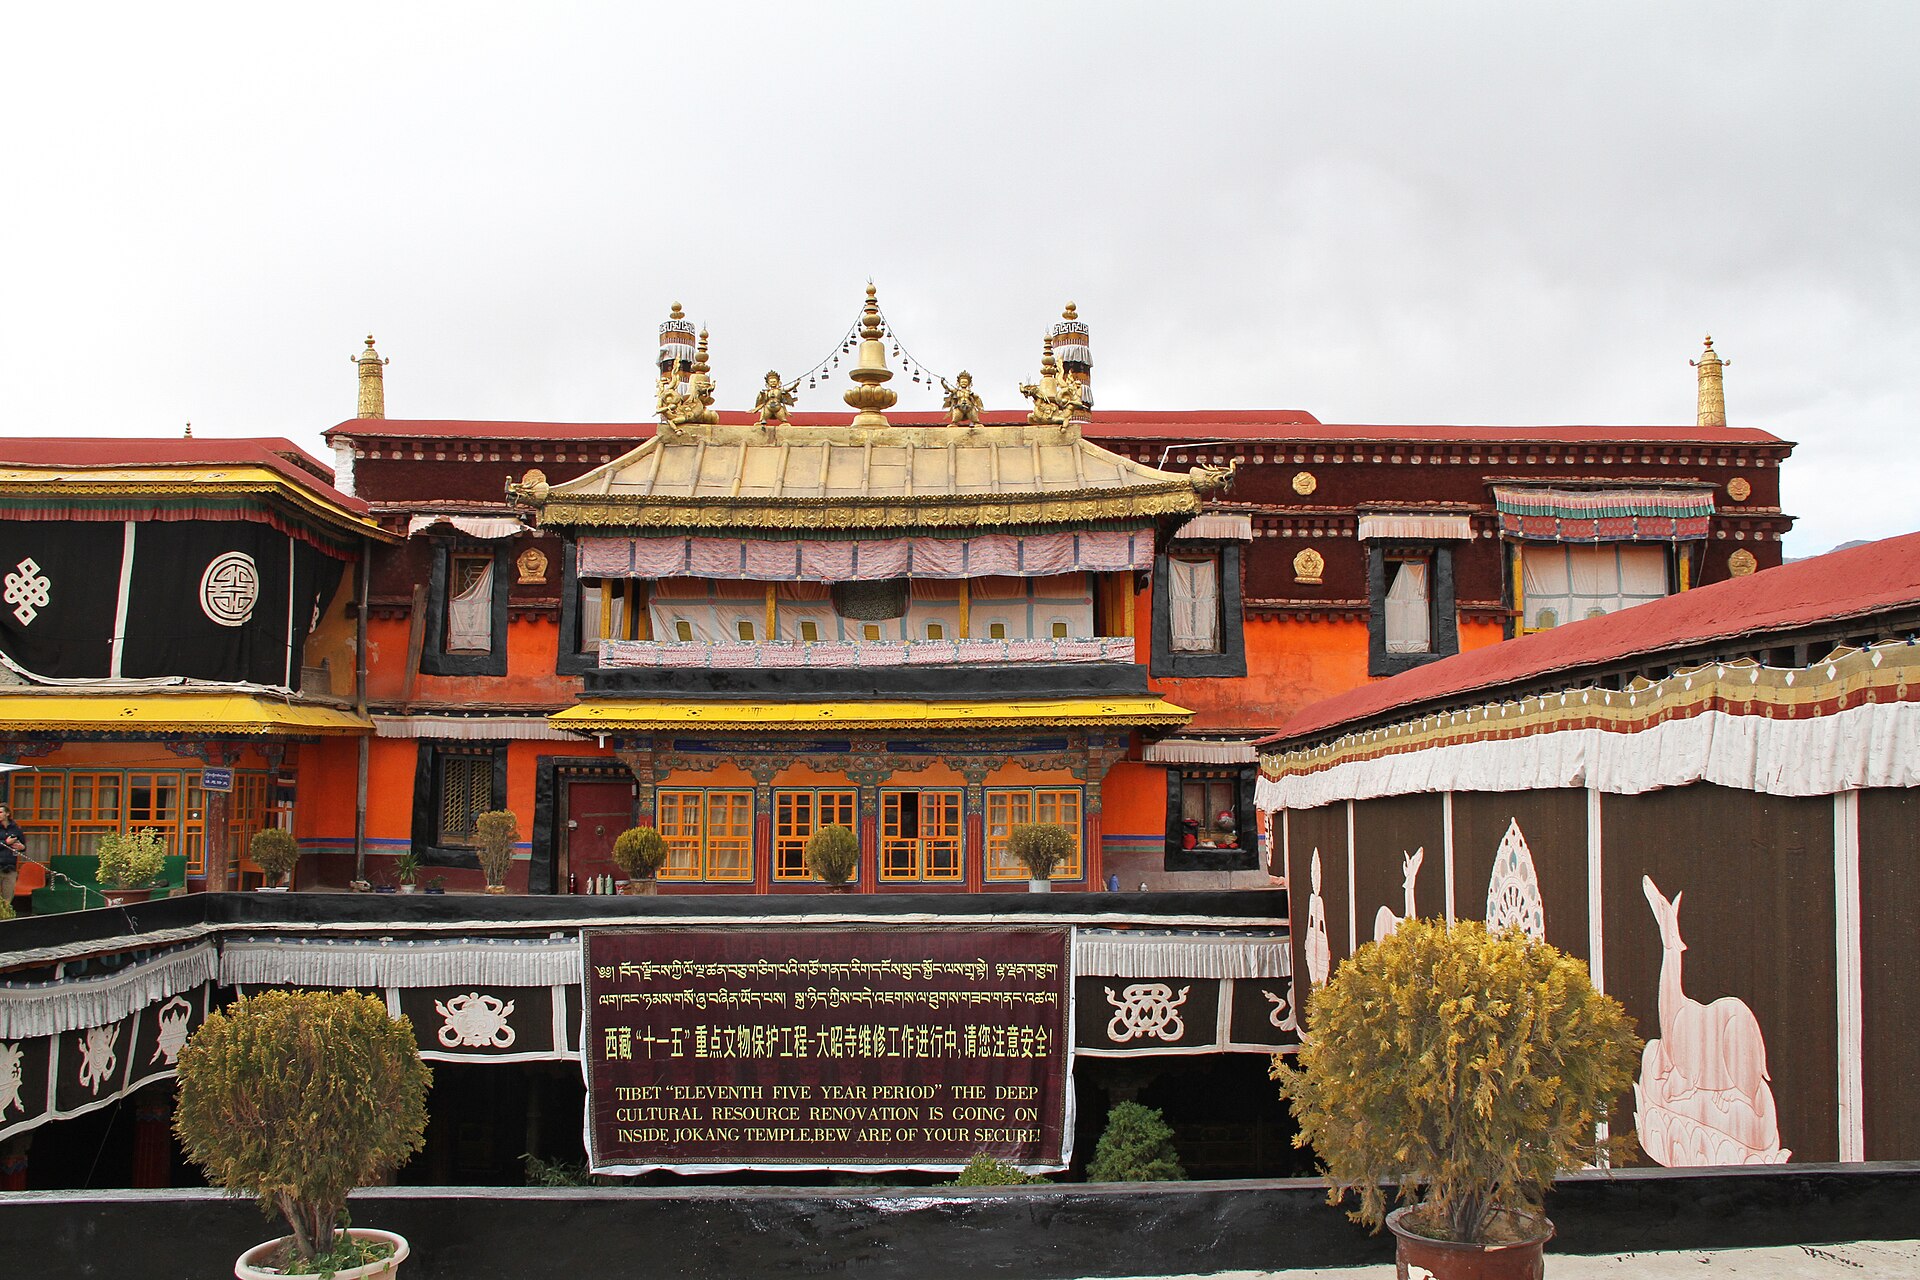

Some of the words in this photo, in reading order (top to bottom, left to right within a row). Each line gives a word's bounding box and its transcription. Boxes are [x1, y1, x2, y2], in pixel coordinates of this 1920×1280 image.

[615, 1086, 662, 1101] TIBET
[666, 1085, 763, 1100] “ELEVENTH
[772, 1085, 811, 1100] FIVE
[820, 1085, 867, 1100] YEAR
[872, 1084, 942, 1100] PERIOD”
[951, 1085, 986, 1100] THE
[995, 1086, 1038, 1100] DEEP
[616, 1107, 703, 1122] CULTURAL
[712, 1107, 800, 1121] RESOURCE
[809, 1107, 919, 1121] RENOVATION
[928, 1107, 944, 1121] IS
[952, 1107, 1006, 1121] GOING
[1015, 1107, 1038, 1121] ON
[618, 1129, 669, 1143] INSIDE
[673, 1128, 740, 1143] JOKANG
[896, 1128, 918, 1142] OF
[923, 1128, 970, 1142] YOUR
[974, 1128, 1041, 1143] SECURE!
